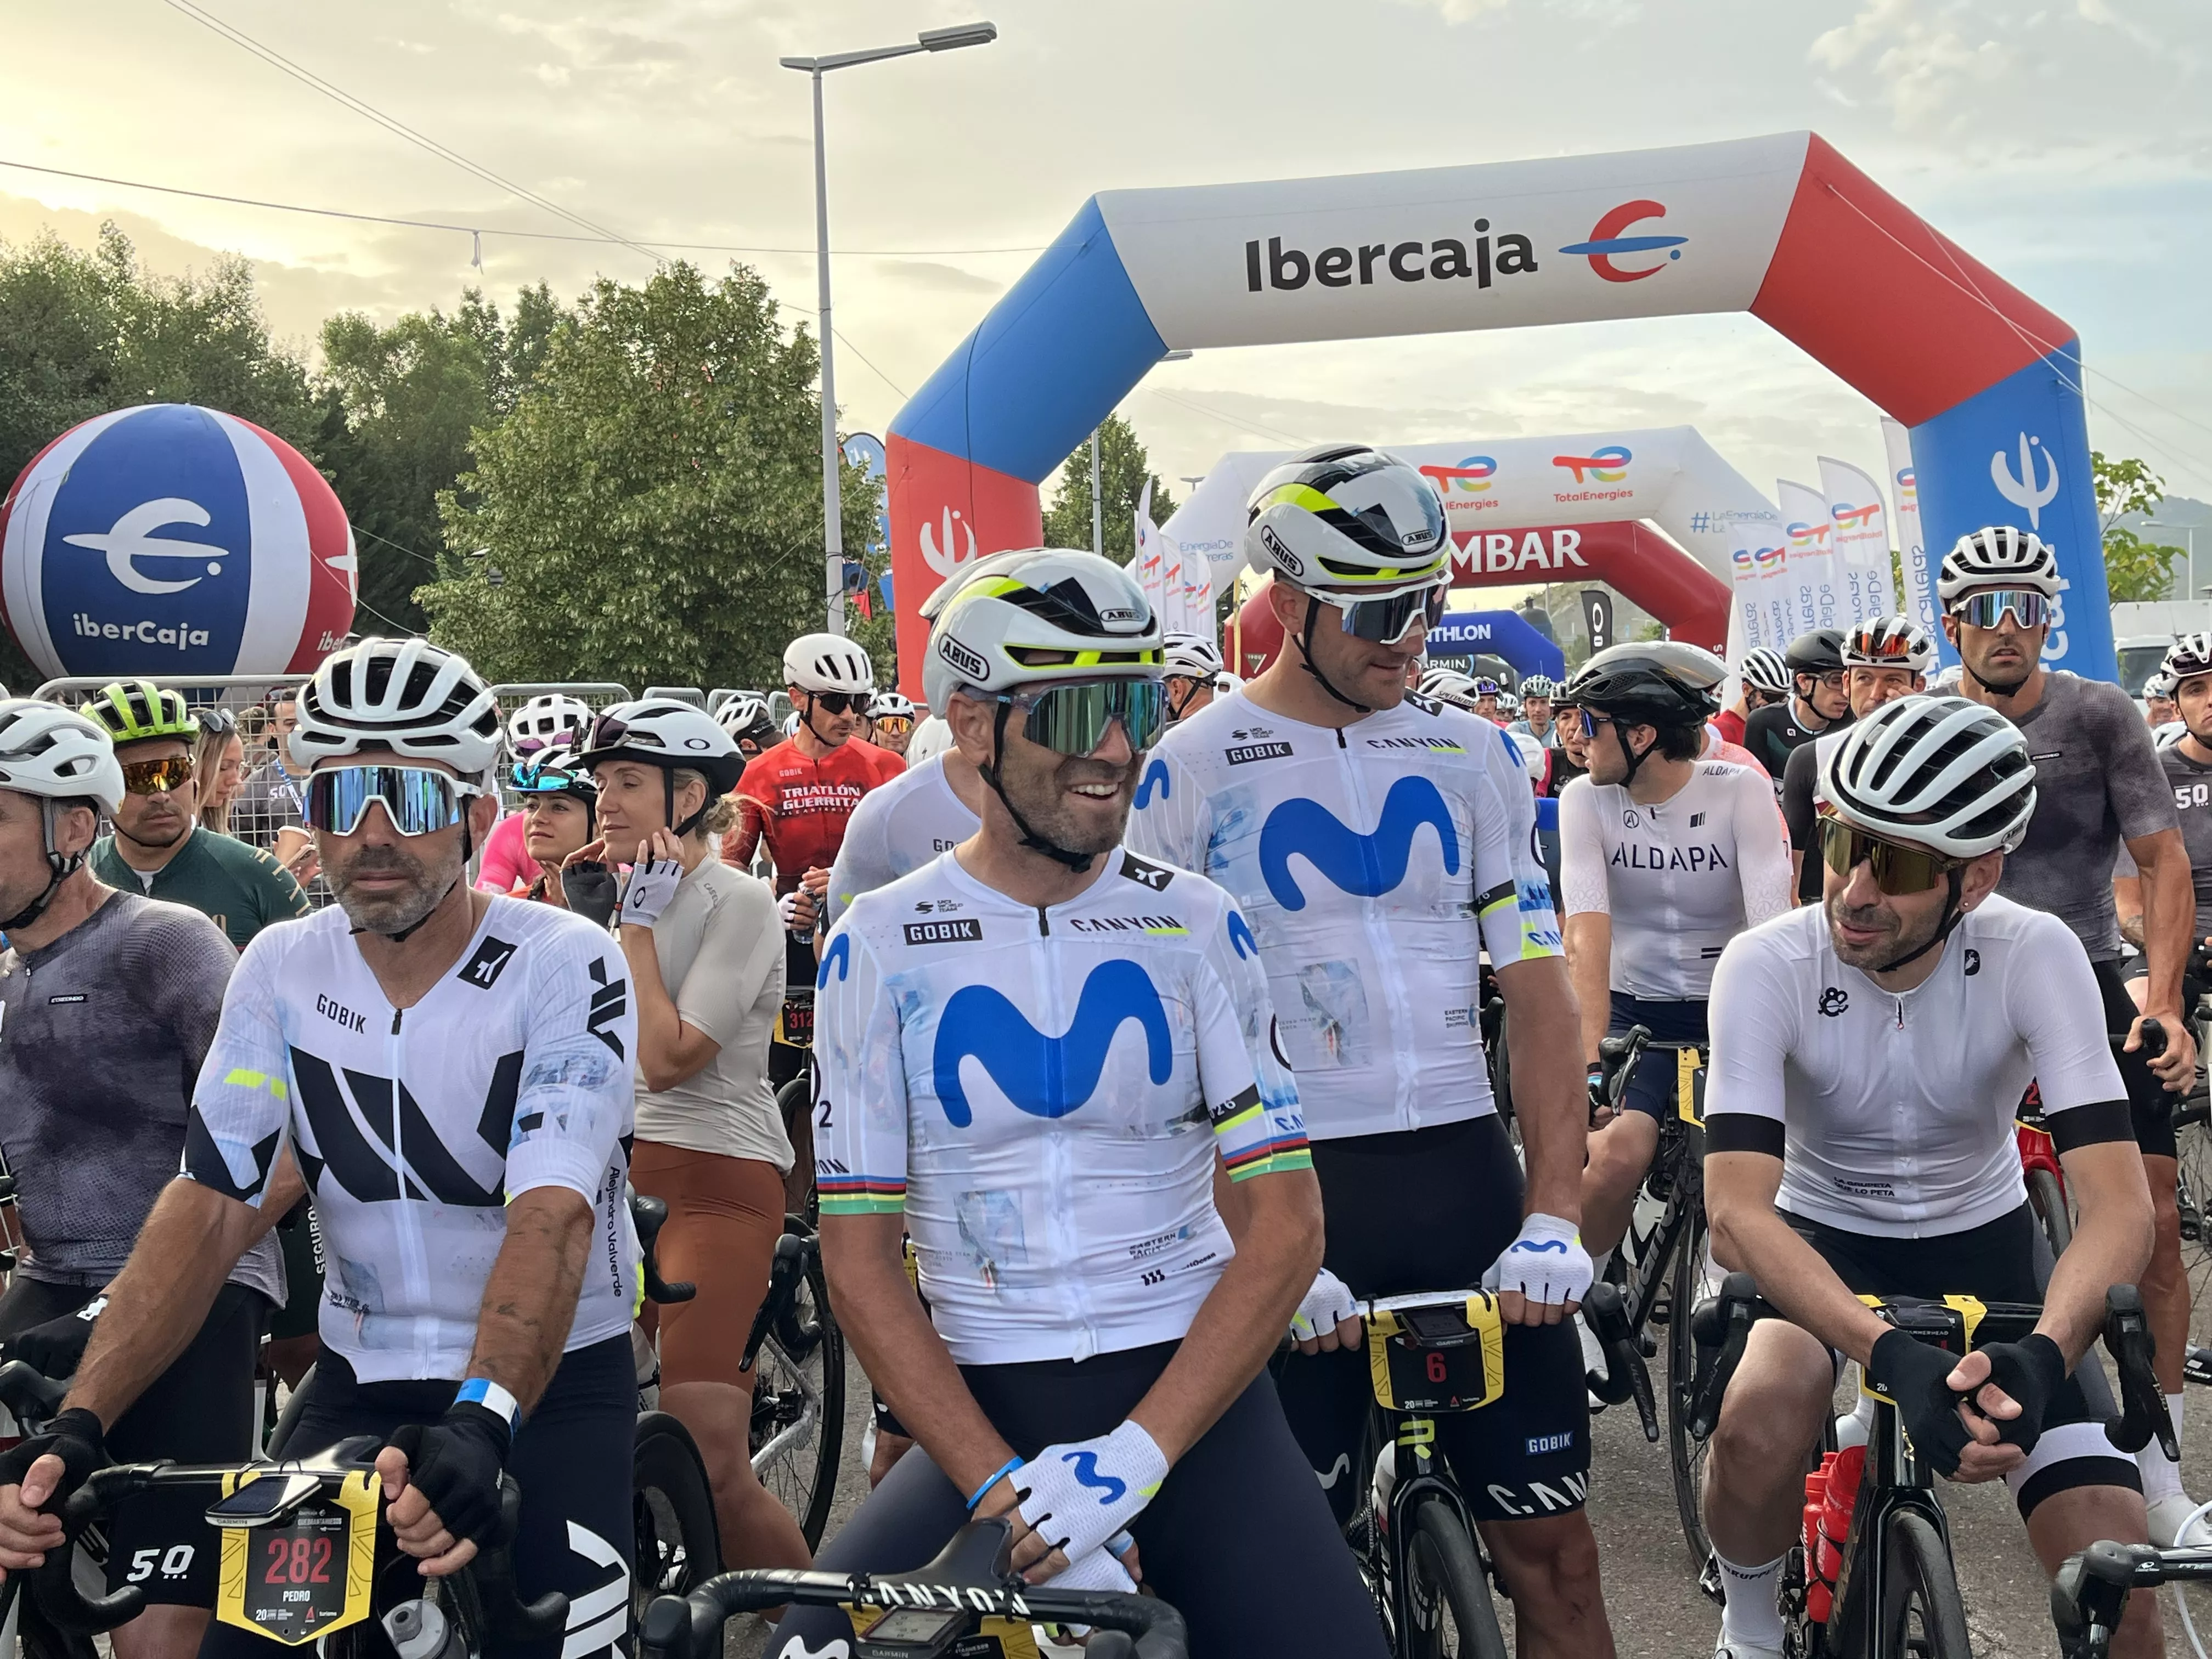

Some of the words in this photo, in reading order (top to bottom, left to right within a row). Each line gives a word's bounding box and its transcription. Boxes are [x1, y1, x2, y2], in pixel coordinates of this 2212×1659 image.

[1245, 218, 1538, 292] Ibercaja
[1446, 499, 1498, 510] lEnergies
[1554, 489, 1633, 502] TotalEnergies
[1408, 532, 1433, 543] ABUS
[1265, 532, 1297, 571] ABUS
[1449, 529, 1589, 573] MBAR
[1108, 610, 1140, 619] ABUS
[73, 614, 208, 651] iberCaja
[317, 630, 348, 652] iber
[1427, 624, 1491, 642] THLON
[943, 641, 981, 675] ABUS
[1425, 659, 1465, 669] ARMIN
[1231, 744, 1286, 761] GOBIK
[1367, 738, 1459, 749] CANYON
[779, 768, 803, 777] GOBIK
[1702, 765, 1740, 776] ALDAPA
[782, 784, 860, 799] TRIATLÓN
[783, 797, 861, 810] GUERRITA
[1611, 842, 1728, 871] ALDAPA
[910, 922, 974, 941] GOBIK
[1070, 916, 1183, 933] CANYON
[315, 993, 366, 1034] GOBIK
[606, 1166, 620, 1229] Alejandro
[308, 1206, 326, 1274] SEGURO
[607, 1231, 622, 1297] Valverde
[1426, 1352, 1447, 1383] 6
[1404, 1401, 1415, 1409] 20
[1528, 1433, 1571, 1453] GOBIK
[266, 1537, 332, 1584] 282
[283, 1590, 311, 1602] PEDRO
[256, 1609, 267, 1621] 20
